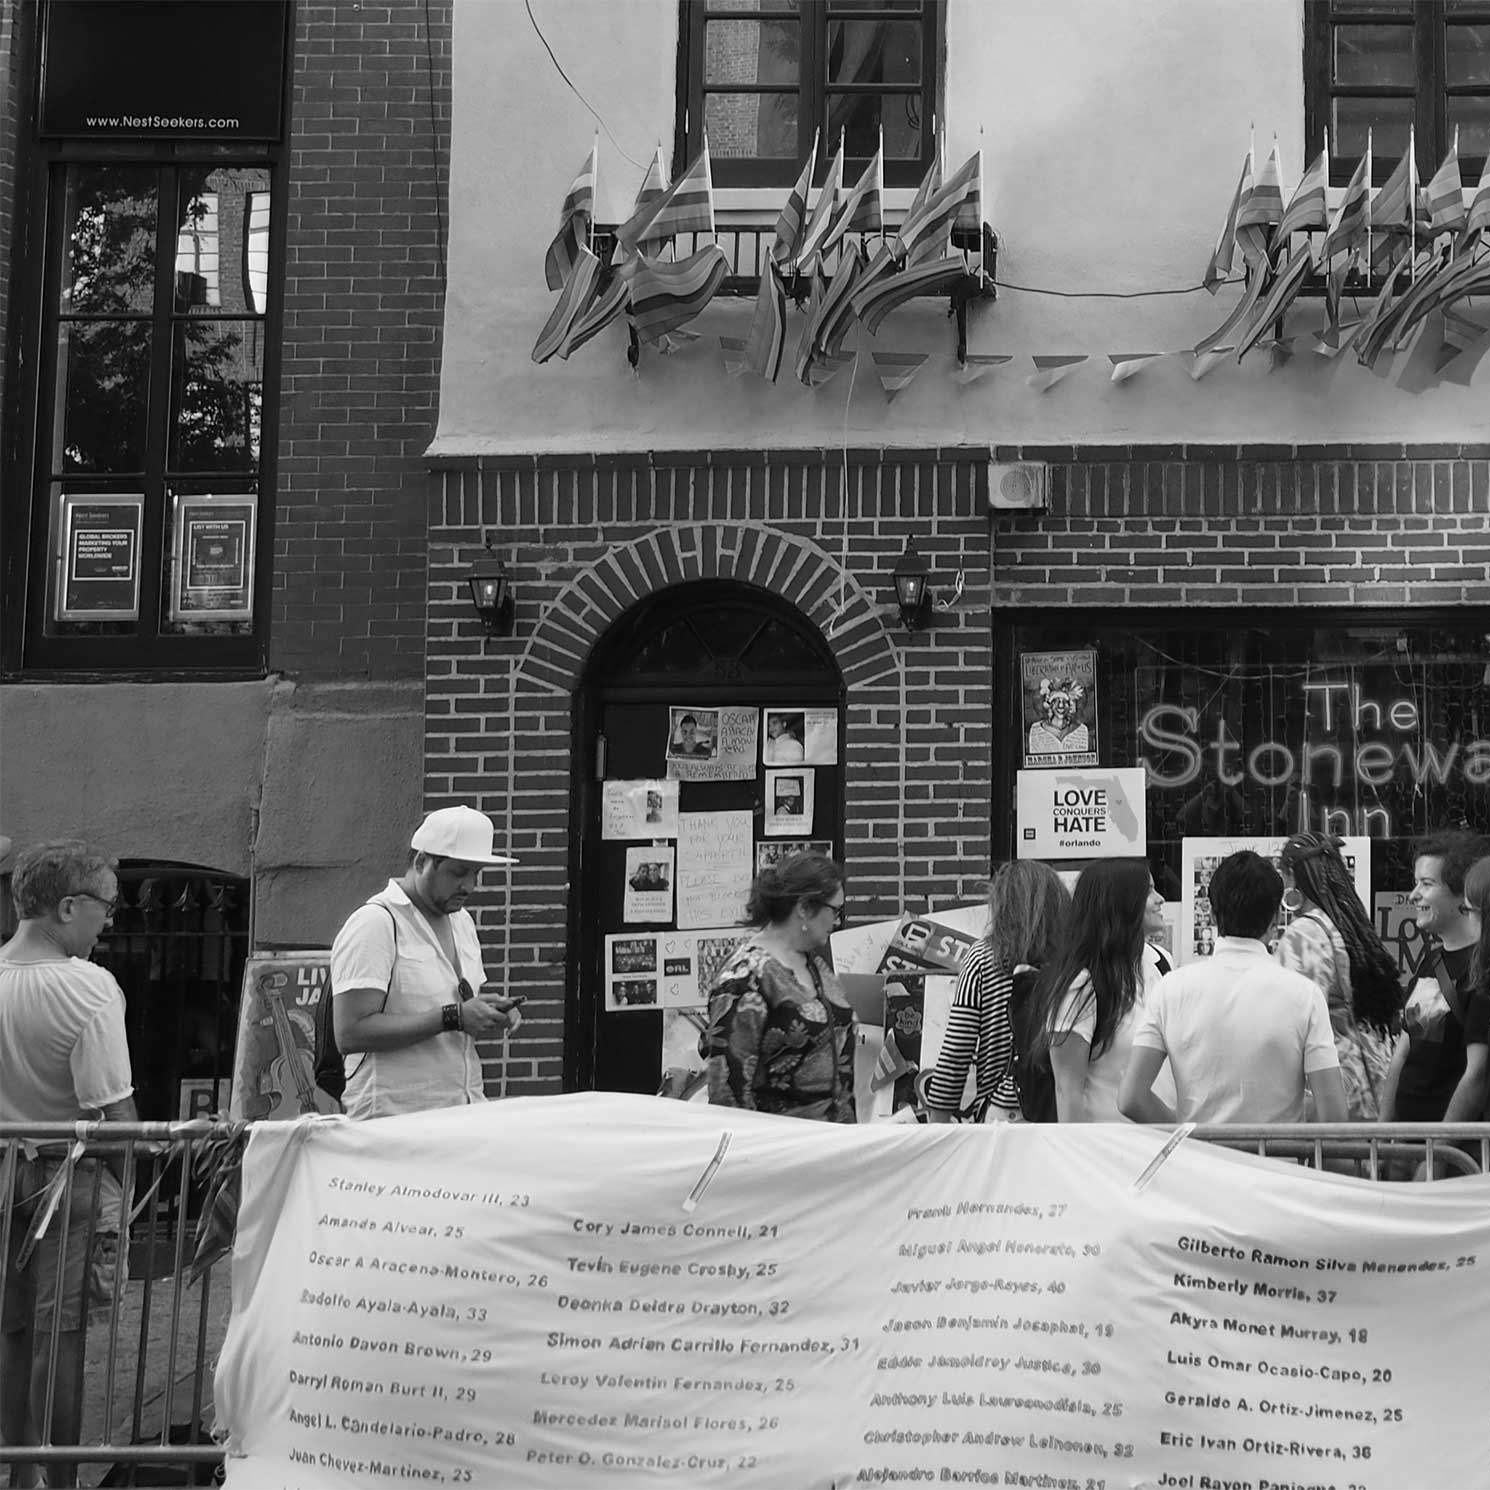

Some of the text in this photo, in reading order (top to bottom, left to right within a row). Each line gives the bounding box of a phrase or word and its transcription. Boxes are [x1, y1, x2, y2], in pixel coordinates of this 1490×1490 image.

[86, 116, 239, 128] www.NestSeekers.com
[1302, 683, 1418, 732] The
[1053, 807, 1106, 816] CONQUERS
[1054, 790, 1106, 806] LOVE
[1054, 817, 1106, 832] HATE
[1301, 790, 1391, 840] Inn
[328, 1176, 530, 1208] Stanley Almodovar III, 23
[318, 1213, 464, 1239] Amanda Alvear, 25
[573, 1219, 779, 1240] Cory James Connell, 21
[309, 1250, 548, 1288] Oscar A Aracena-Montero, 26
[567, 1255, 778, 1280] Tevin Eugene Crosby, 25
[1177, 1235, 1246, 1262] Gilberto
[1251, 1248, 1310, 1270] Ramon
[1315, 1258, 1357, 1273] Silva
[1455, 1255, 1476, 1268] 25
[1173, 1273, 1338, 1304] Kimberly Morris, 37
[557, 1295, 790, 1317] Deonka Deidra Drayton, 32
[547, 1332, 860, 1355] Simon Adrian Carrillo Fernandez, 31
[1170, 1311, 1368, 1345] Akyra Monet Murray, 18
[292, 1330, 492, 1363] Antonio Davon Brown, 29
[1167, 1351, 1392, 1385] Luis Omar Ocasio-Capo, 20
[289, 1370, 477, 1401] Darryl Roman Burt II, 29
[1164, 1391, 1403, 1424] Geraldo A. Ortiz-Jimenez, 25
[289, 1409, 516, 1446] Angel L. Candelario-Padro, 28
[525, 1449, 757, 1471] Peter O. Gonzalez-Cruz, 22
[1160, 1431, 1194, 1448] Eric
[1200, 1435, 1237, 1451] Ivan
[1242, 1438, 1347, 1460] Ortiz-Rivera,
[289, 1447, 316, 1465] Juan
[452, 1468, 472, 1482] 25
[1158, 1473, 1194, 1489] Joel
[1199, 1475, 1252, 1490] Rayon
